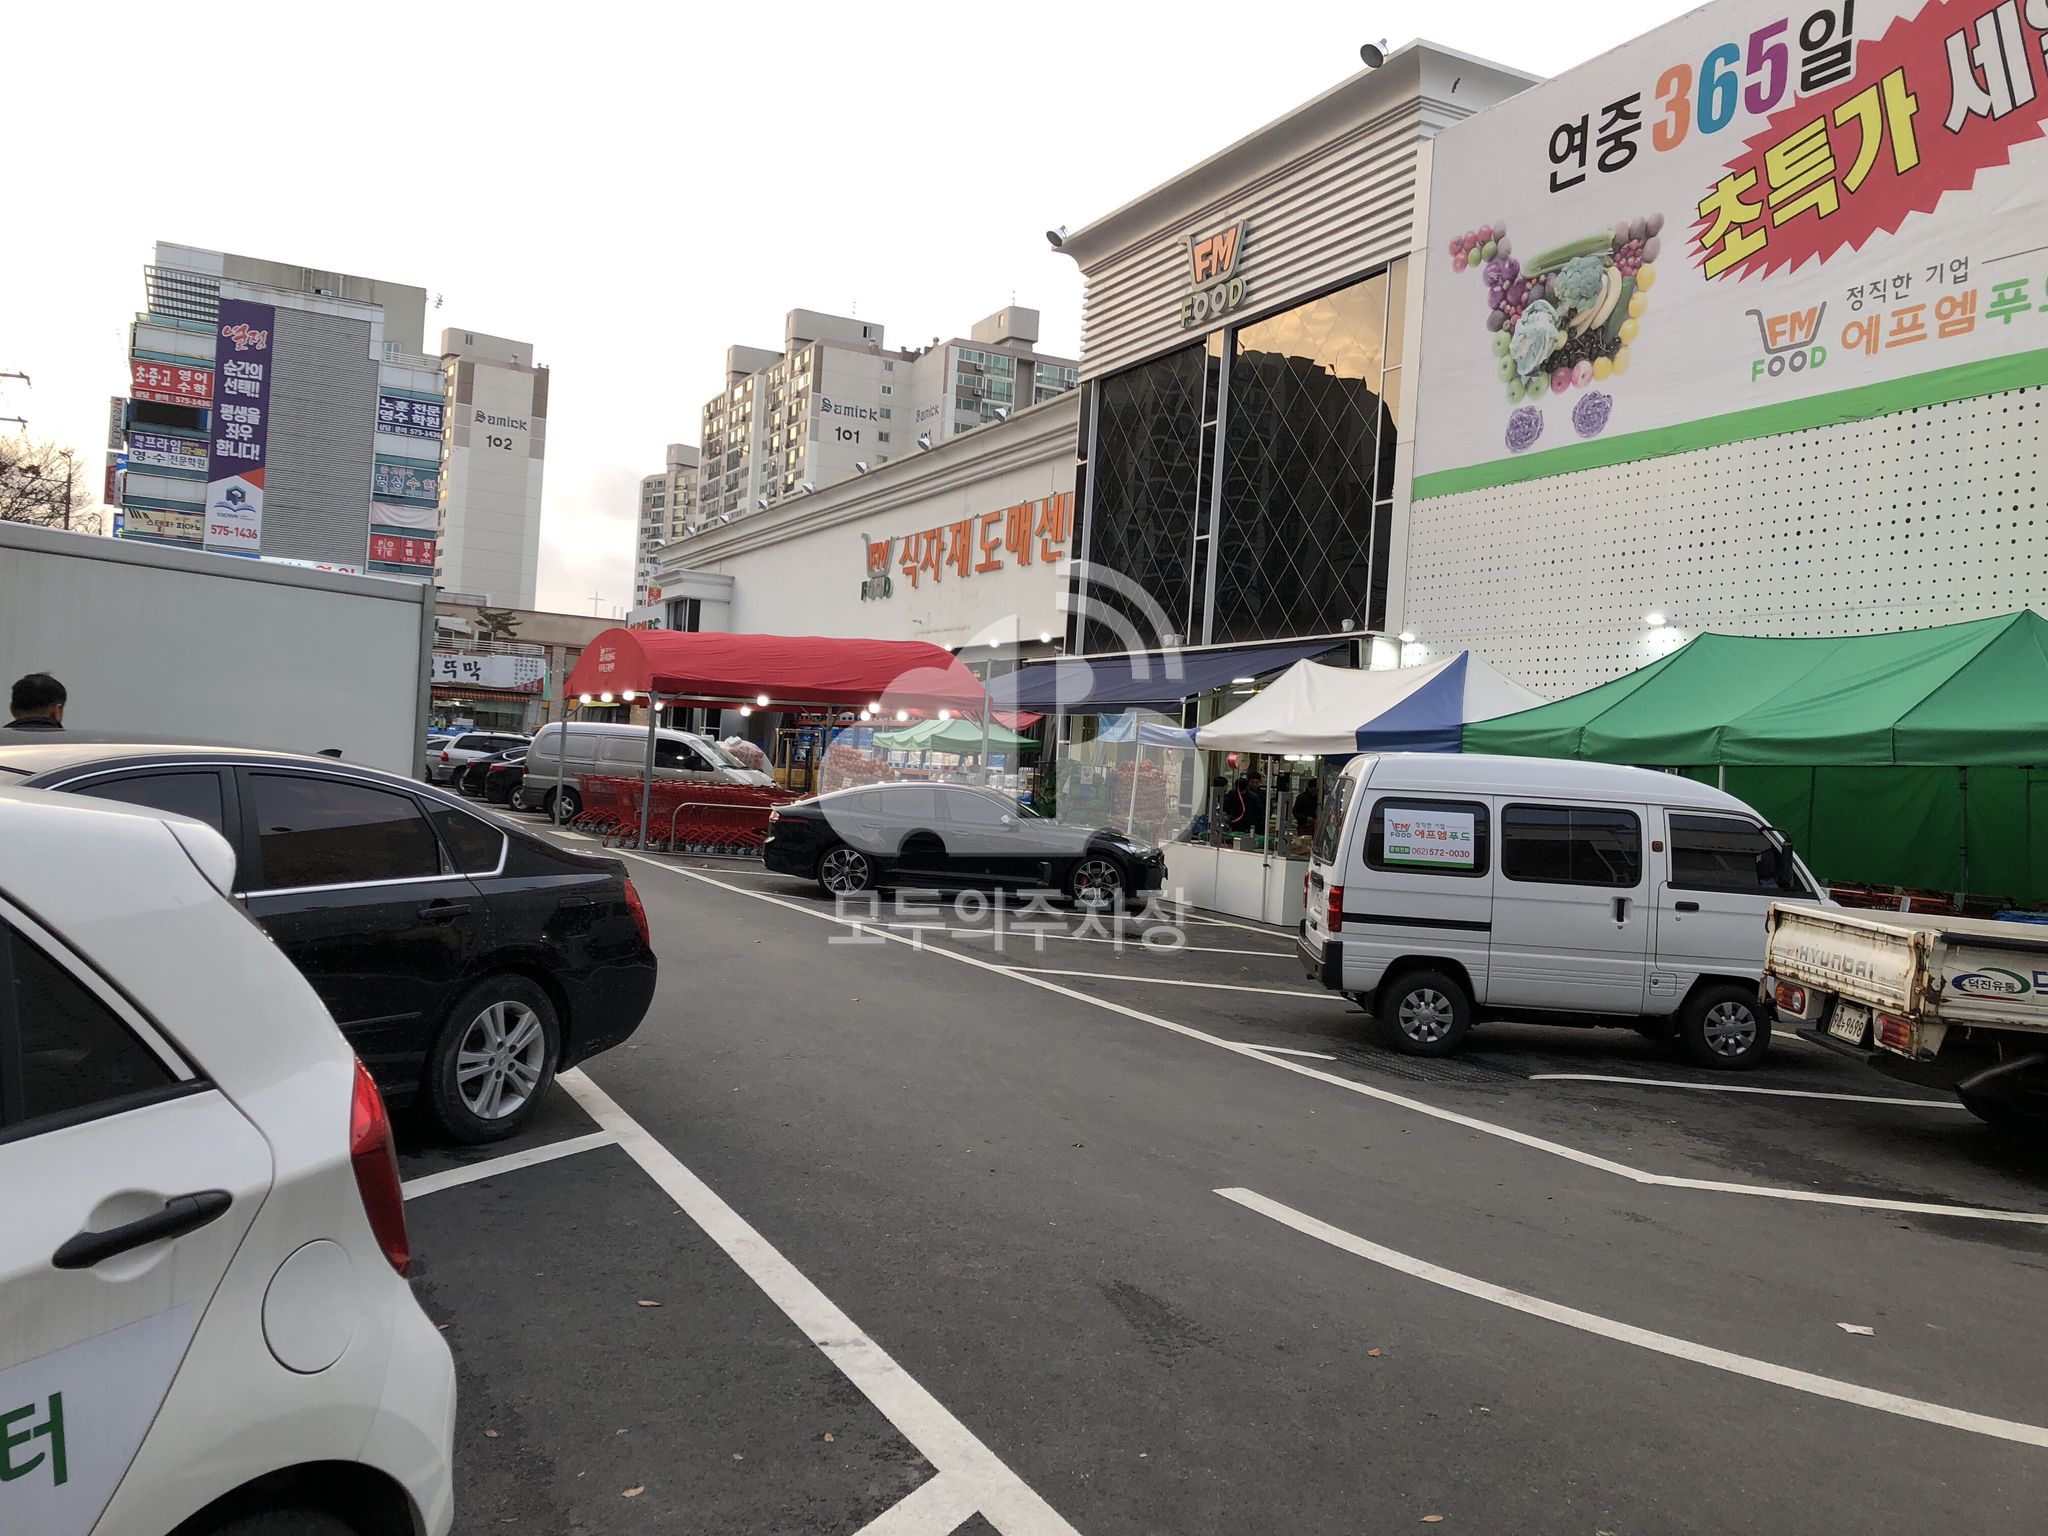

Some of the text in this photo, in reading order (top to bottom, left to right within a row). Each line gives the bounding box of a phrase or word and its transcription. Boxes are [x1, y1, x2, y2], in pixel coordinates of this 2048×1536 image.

[1548, 91, 1642, 193] 연중
[1698, 65, 1919, 281] 초특가
[1194, 227, 1238, 284] FM
[1846, 256, 1970, 312] 정직한 기업
[1181, 277, 1245, 328] FOOD
[222, 323, 268, 351] 열정
[1766, 306, 1819, 347] FM
[223, 359, 263, 380] 순간의
[1750, 346, 1828, 383] FOOD
[178, 369, 208, 384] 영어
[177, 381, 208, 396] 수학
[224, 377, 260, 398] 선택!!
[175, 396, 211, 408] 575-1436
[412, 402, 441, 417] 전문
[820, 397, 878, 422] Samick
[220, 403, 260, 425] 평생을
[379, 409, 441, 428] 영수 학원
[474, 409, 528, 431] Samick
[225, 422, 253, 441] 좌우
[409, 428, 440, 438] 575-1436
[834, 426, 860, 444] 101
[144, 436, 181, 454] 프라임
[216, 439, 260, 461] 합니다!
[486, 435, 513, 451] 102
[169, 454, 206, 469] 전문학원
[211, 524, 258, 539] 575-1436
[899, 491, 1074, 589] 식자재도매센
[861, 576, 893, 601] FOOD
[431, 658, 482, 682] 뚜막
[1394, 822, 1409, 830] FM
[1414, 829, 1471, 841] 에프엠푸드
[1968, 978, 2016, 992] 덕진유통
